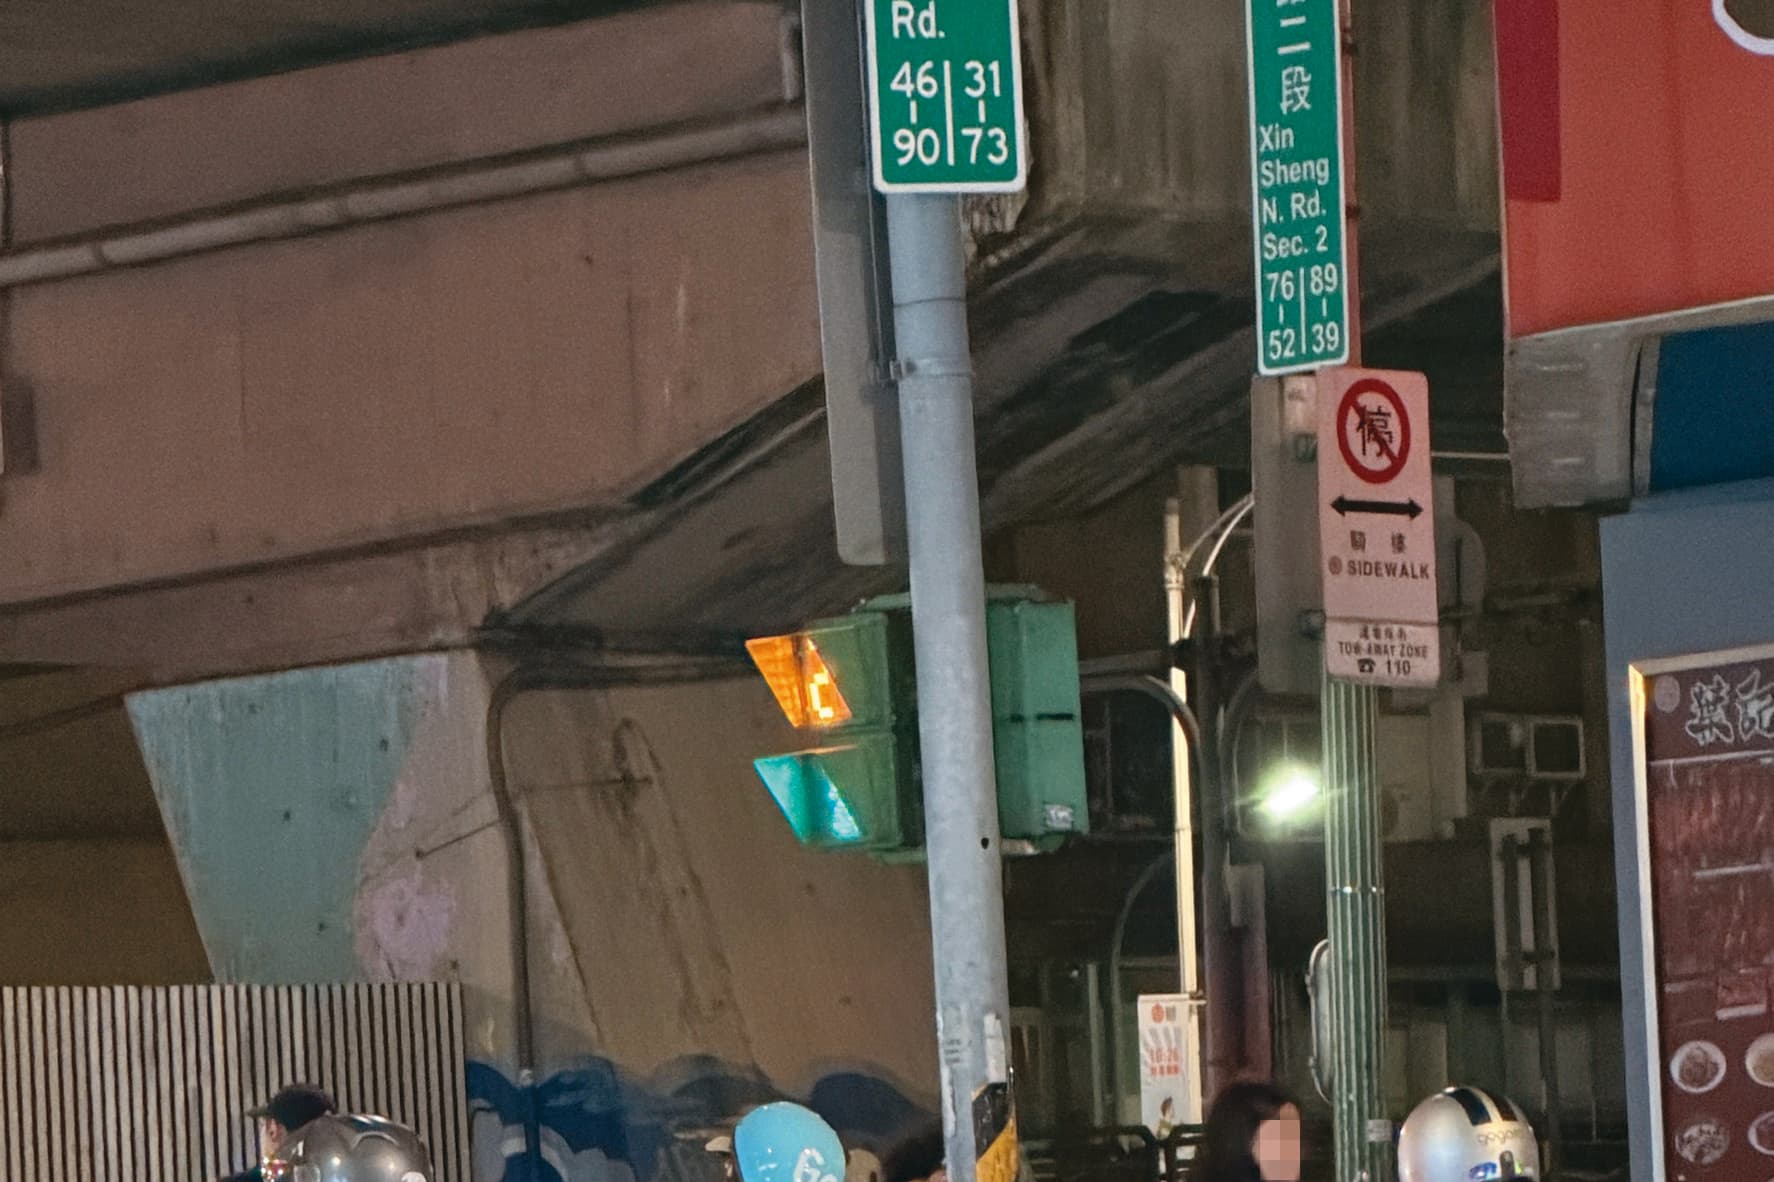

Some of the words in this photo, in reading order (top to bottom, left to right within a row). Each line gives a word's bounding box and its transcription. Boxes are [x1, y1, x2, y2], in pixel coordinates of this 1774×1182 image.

[891, 0, 946, 39] Rd.
[890, 60, 939, 98] 46
[964, 60, 1001, 98] 31
[893, 128, 941, 166] 90
[961, 127, 1009, 165] 73
[1259, 122, 1295, 153] Xin
[1260, 157, 1329, 187] Sheng
[1262, 196, 1284, 225] N.
[1291, 188, 1327, 220] Rd.
[1263, 231, 1309, 260] Sec.
[1315, 224, 1329, 253] 2
[1265, 269, 1295, 302] 76
[1310, 262, 1338, 295] 89
[1269, 328, 1296, 360] 52
[1311, 321, 1340, 354] 39
[1346, 559, 1430, 580] SIDEWALK
[1385, 658, 1412, 676] 110
